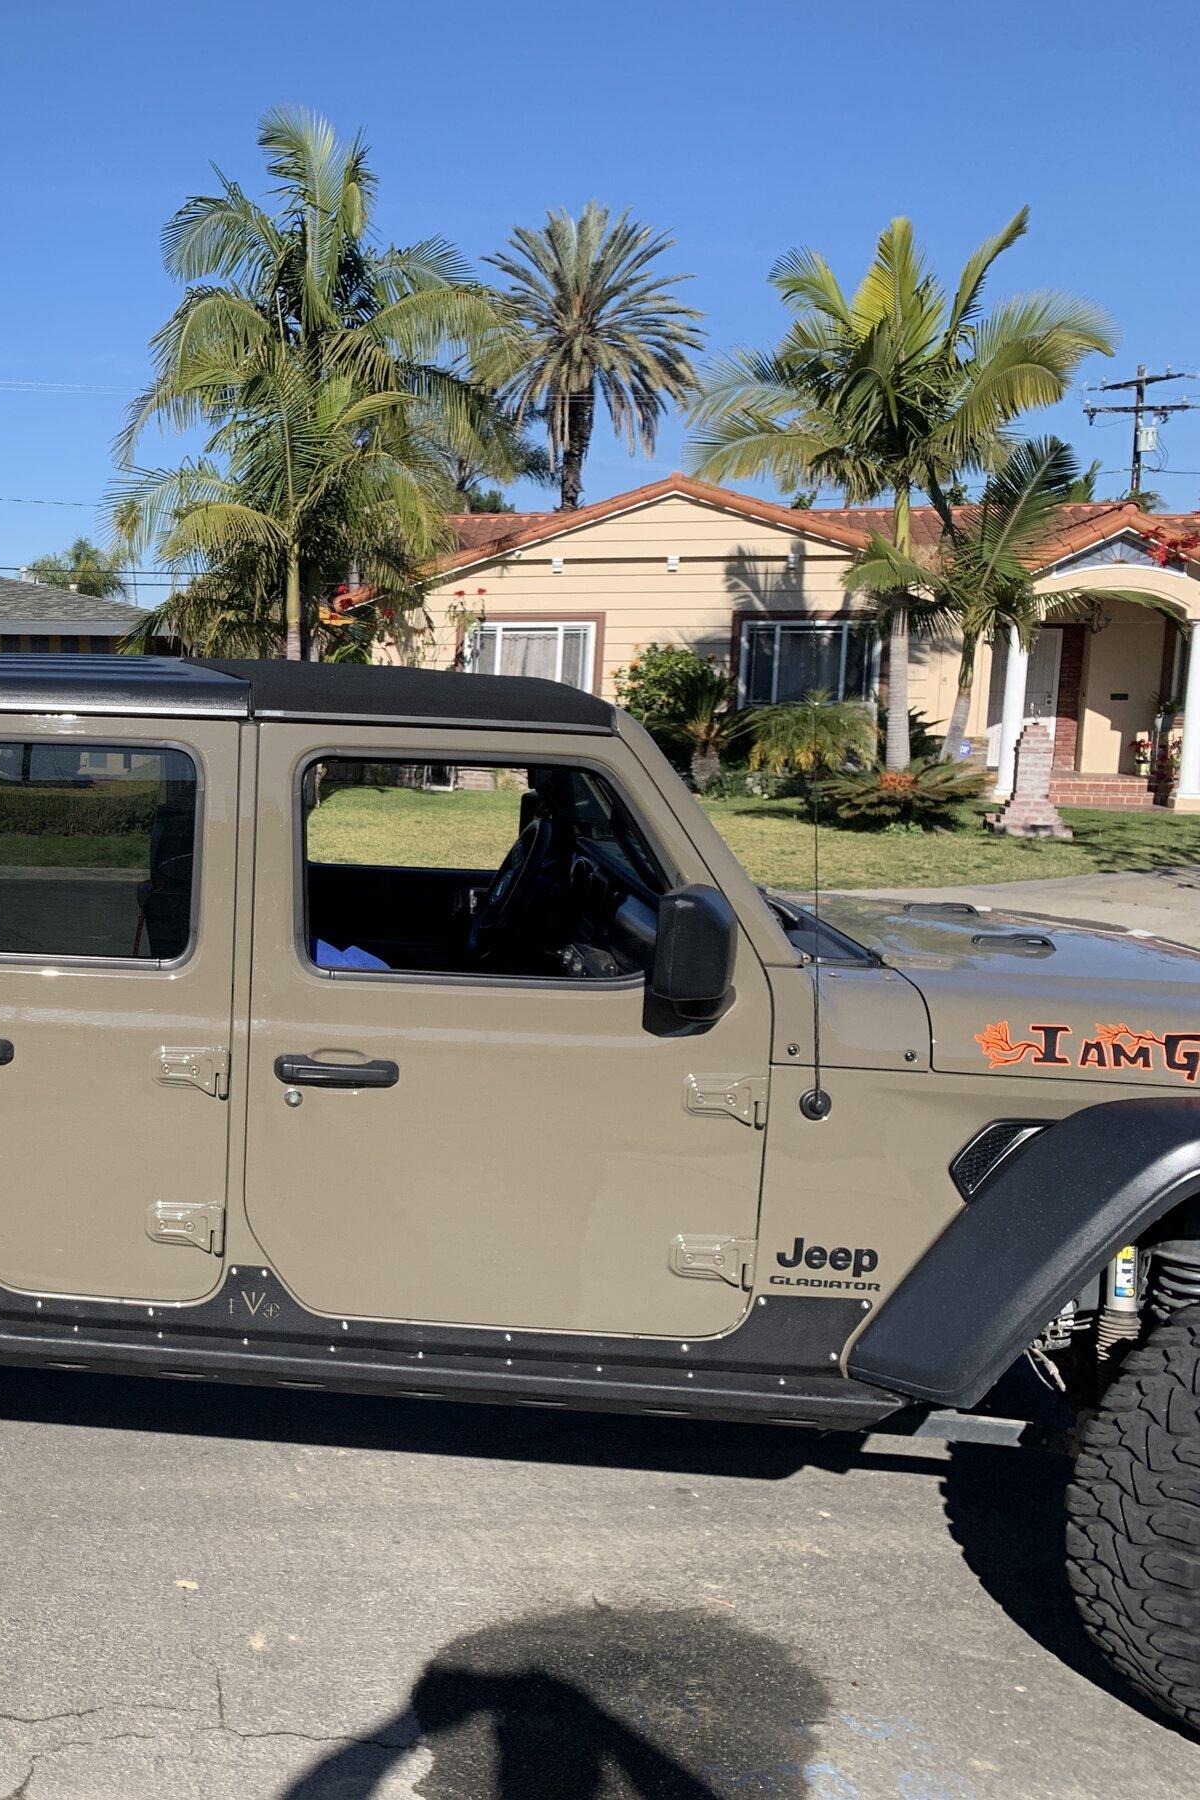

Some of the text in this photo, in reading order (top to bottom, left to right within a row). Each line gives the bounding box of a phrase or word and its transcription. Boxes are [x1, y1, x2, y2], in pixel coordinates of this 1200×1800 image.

[1029, 1023, 1073, 1066] I
[1079, 1040, 1152, 1069] AM
[776, 1237, 879, 1278] Jeep
[769, 1275, 881, 1292] GLADIATOR
